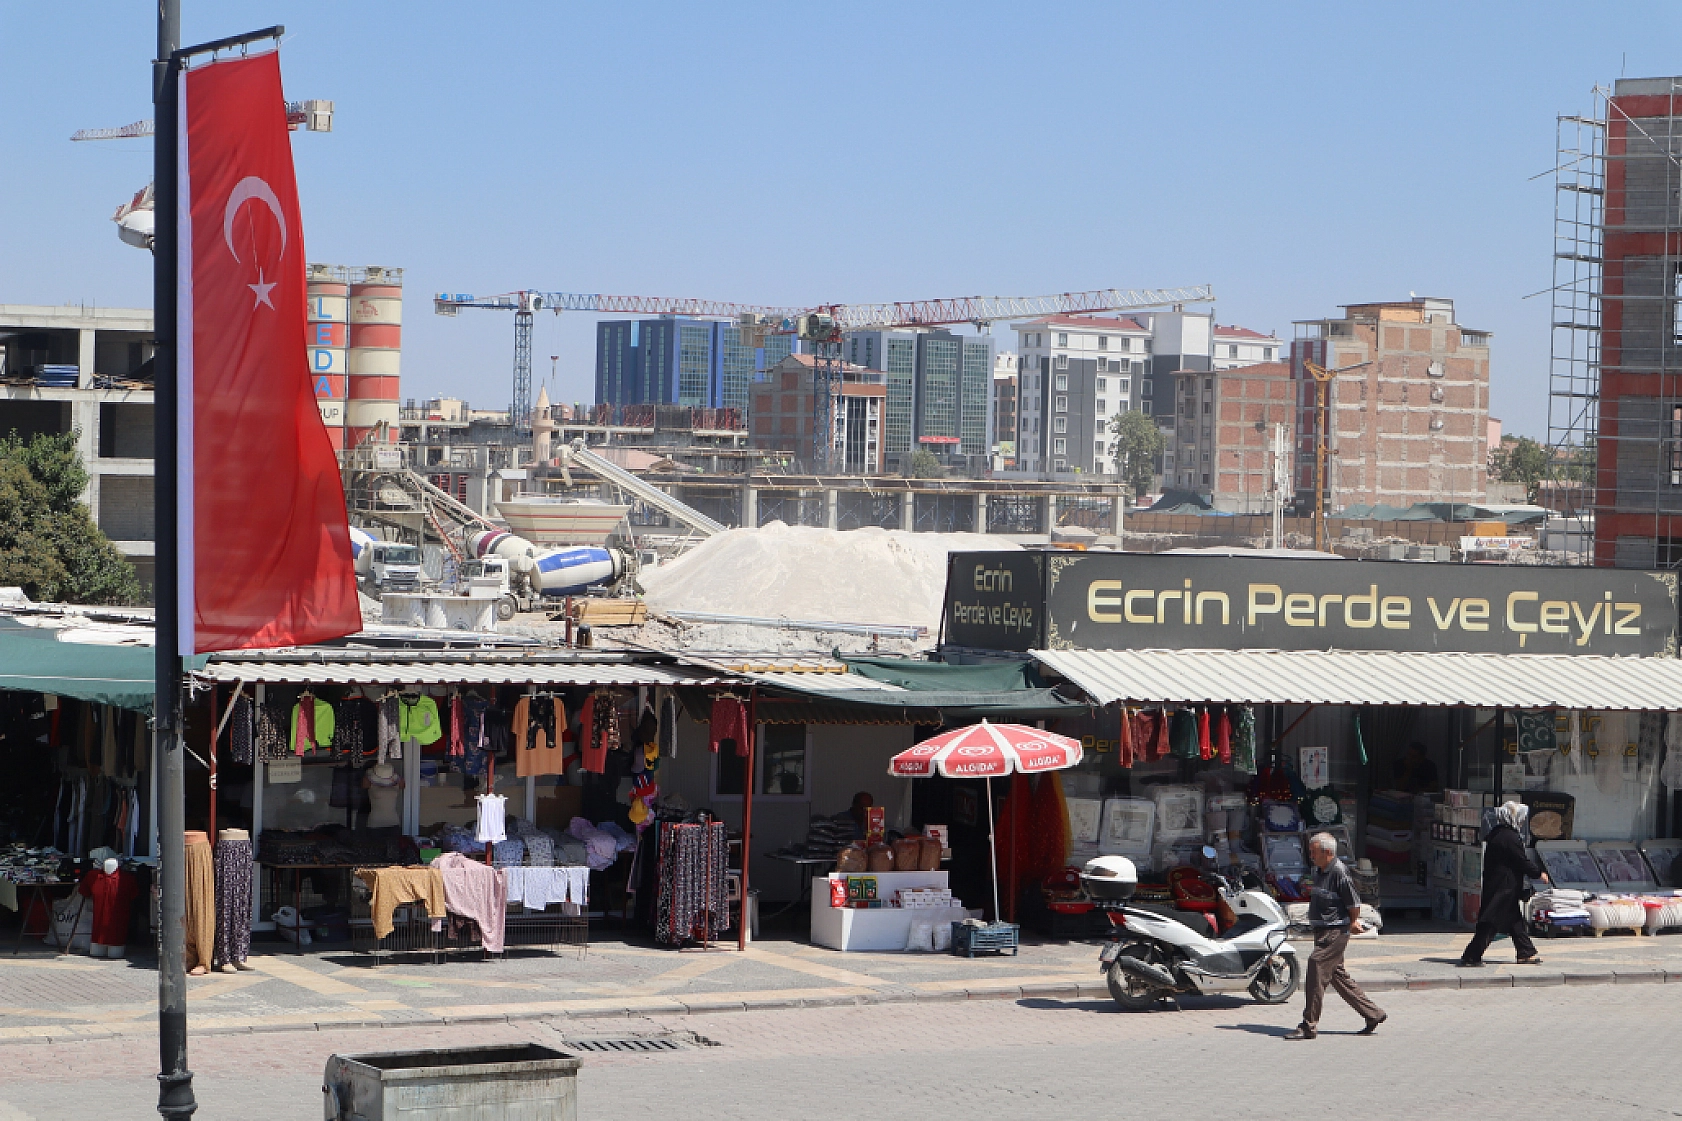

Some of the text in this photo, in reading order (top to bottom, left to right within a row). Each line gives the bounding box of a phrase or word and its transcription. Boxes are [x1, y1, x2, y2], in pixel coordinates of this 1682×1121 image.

[314, 297, 333, 397] LEDA
[974, 562, 1013, 592] Ecrin
[954, 599, 1032, 634] Perde ve Çeyiz
[1088, 578, 1643, 648] Ecrin Perde ve Çeyiz
[1081, 735, 1120, 753] Per
